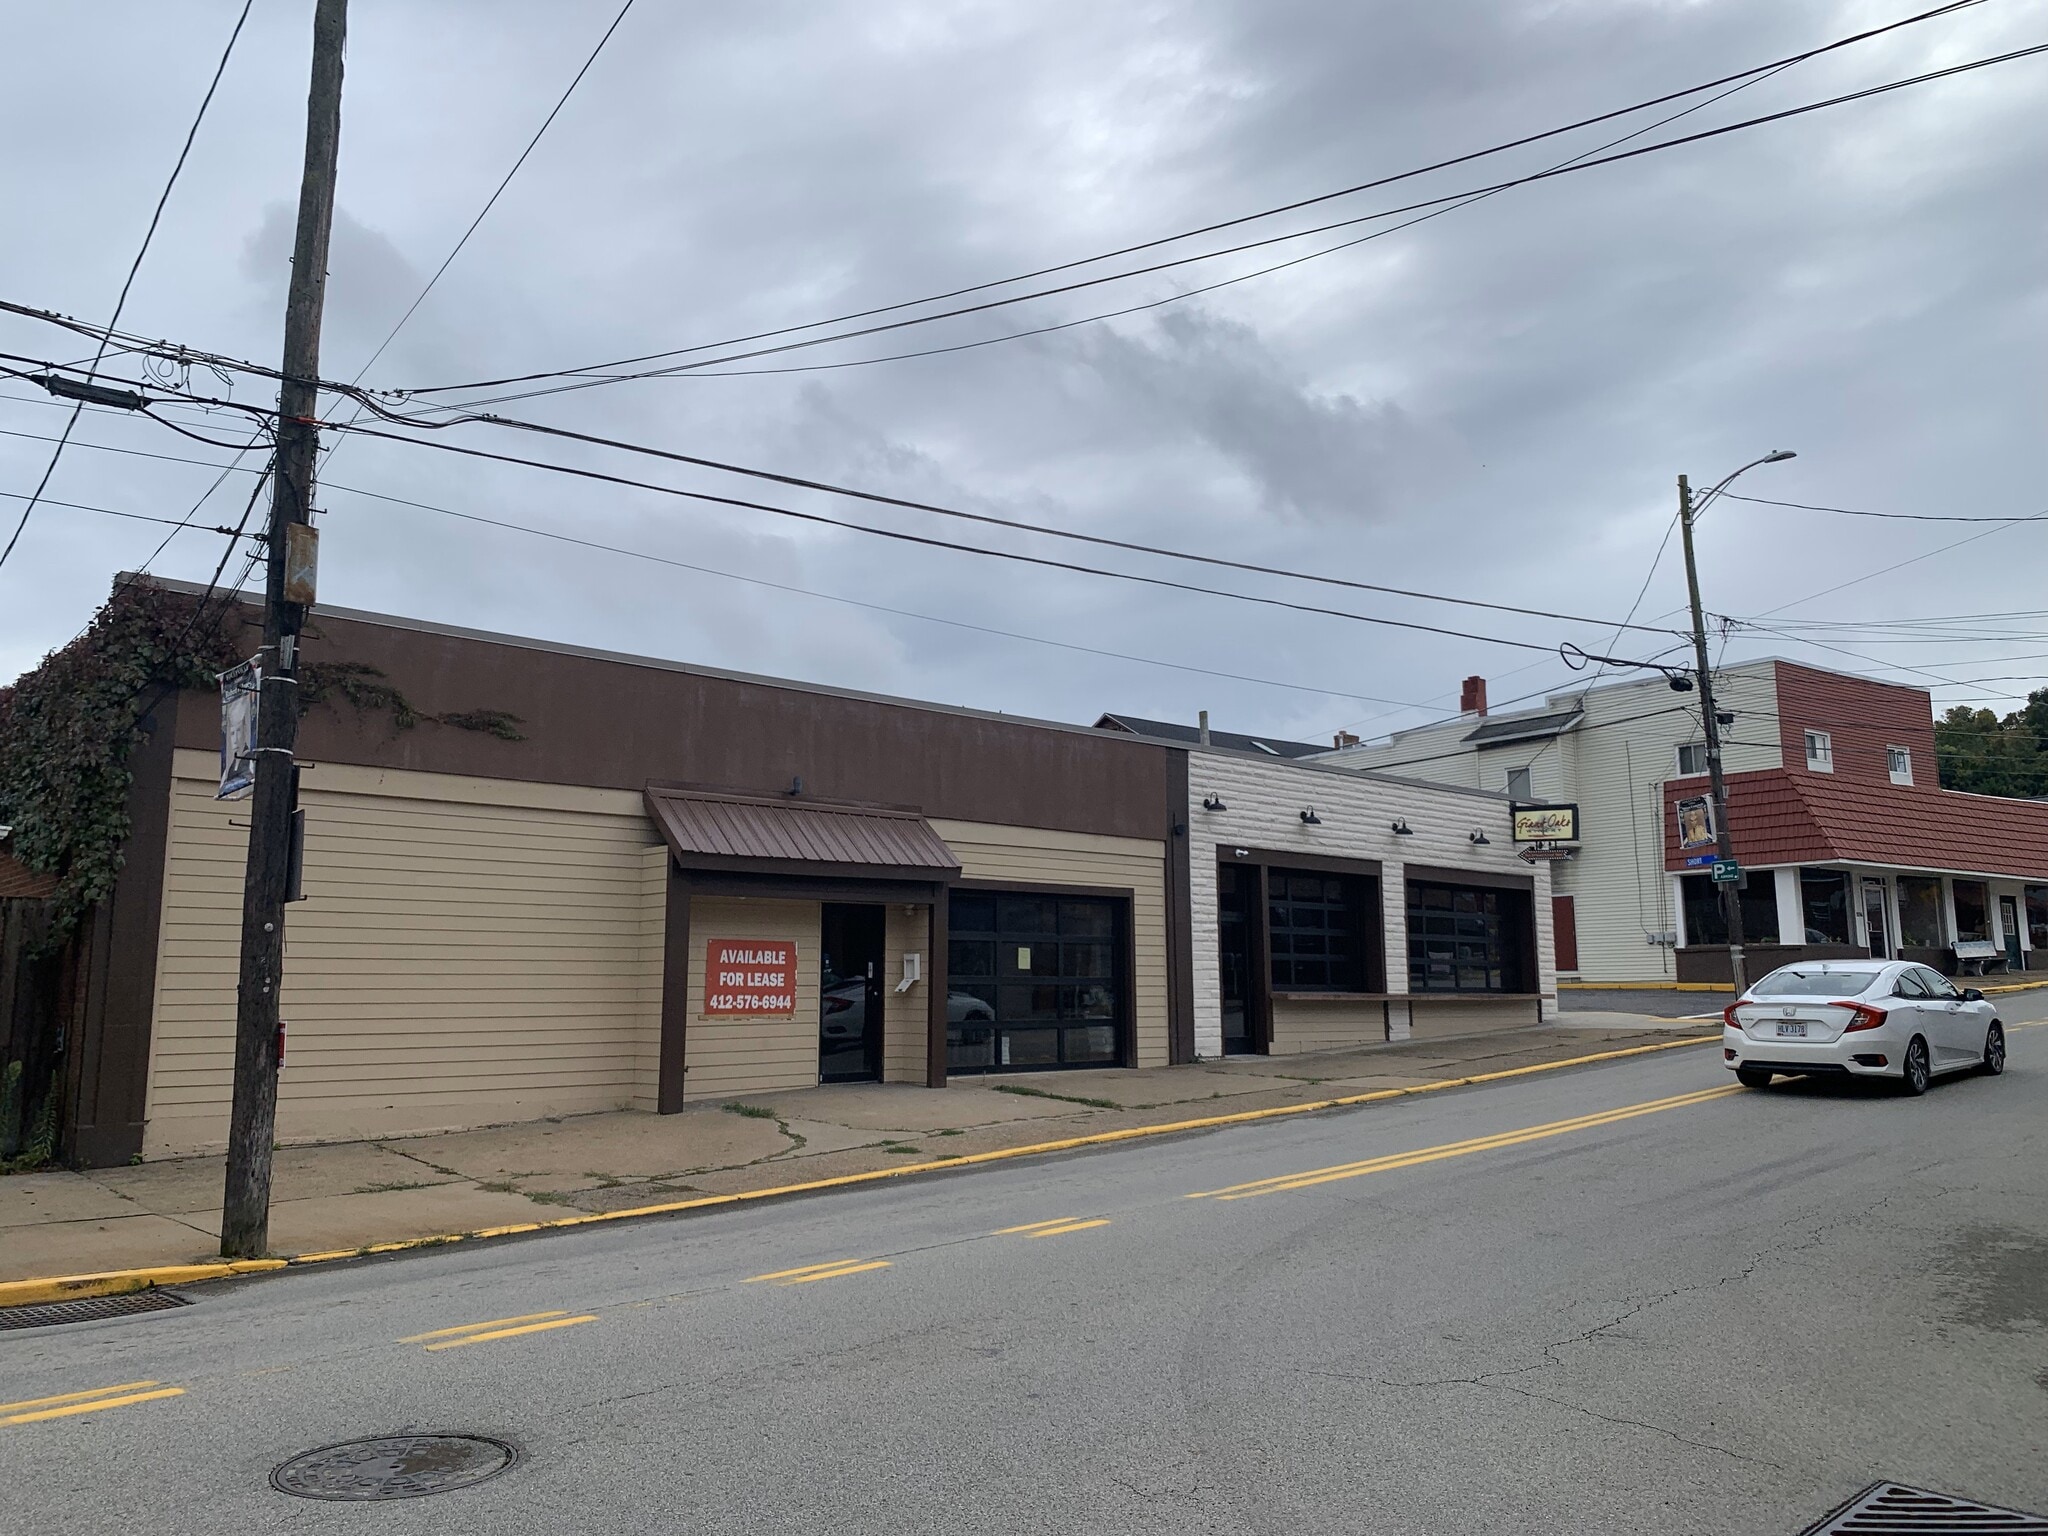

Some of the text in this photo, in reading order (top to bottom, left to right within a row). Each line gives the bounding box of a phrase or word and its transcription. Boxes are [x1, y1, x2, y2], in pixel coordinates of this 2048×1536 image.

[1547, 813, 1571, 828] Oaks
[720, 949, 786, 965] AVAILABLE
[719, 972, 785, 987] FOR LEASE
[710, 995, 791, 1009] 412-576-6944
